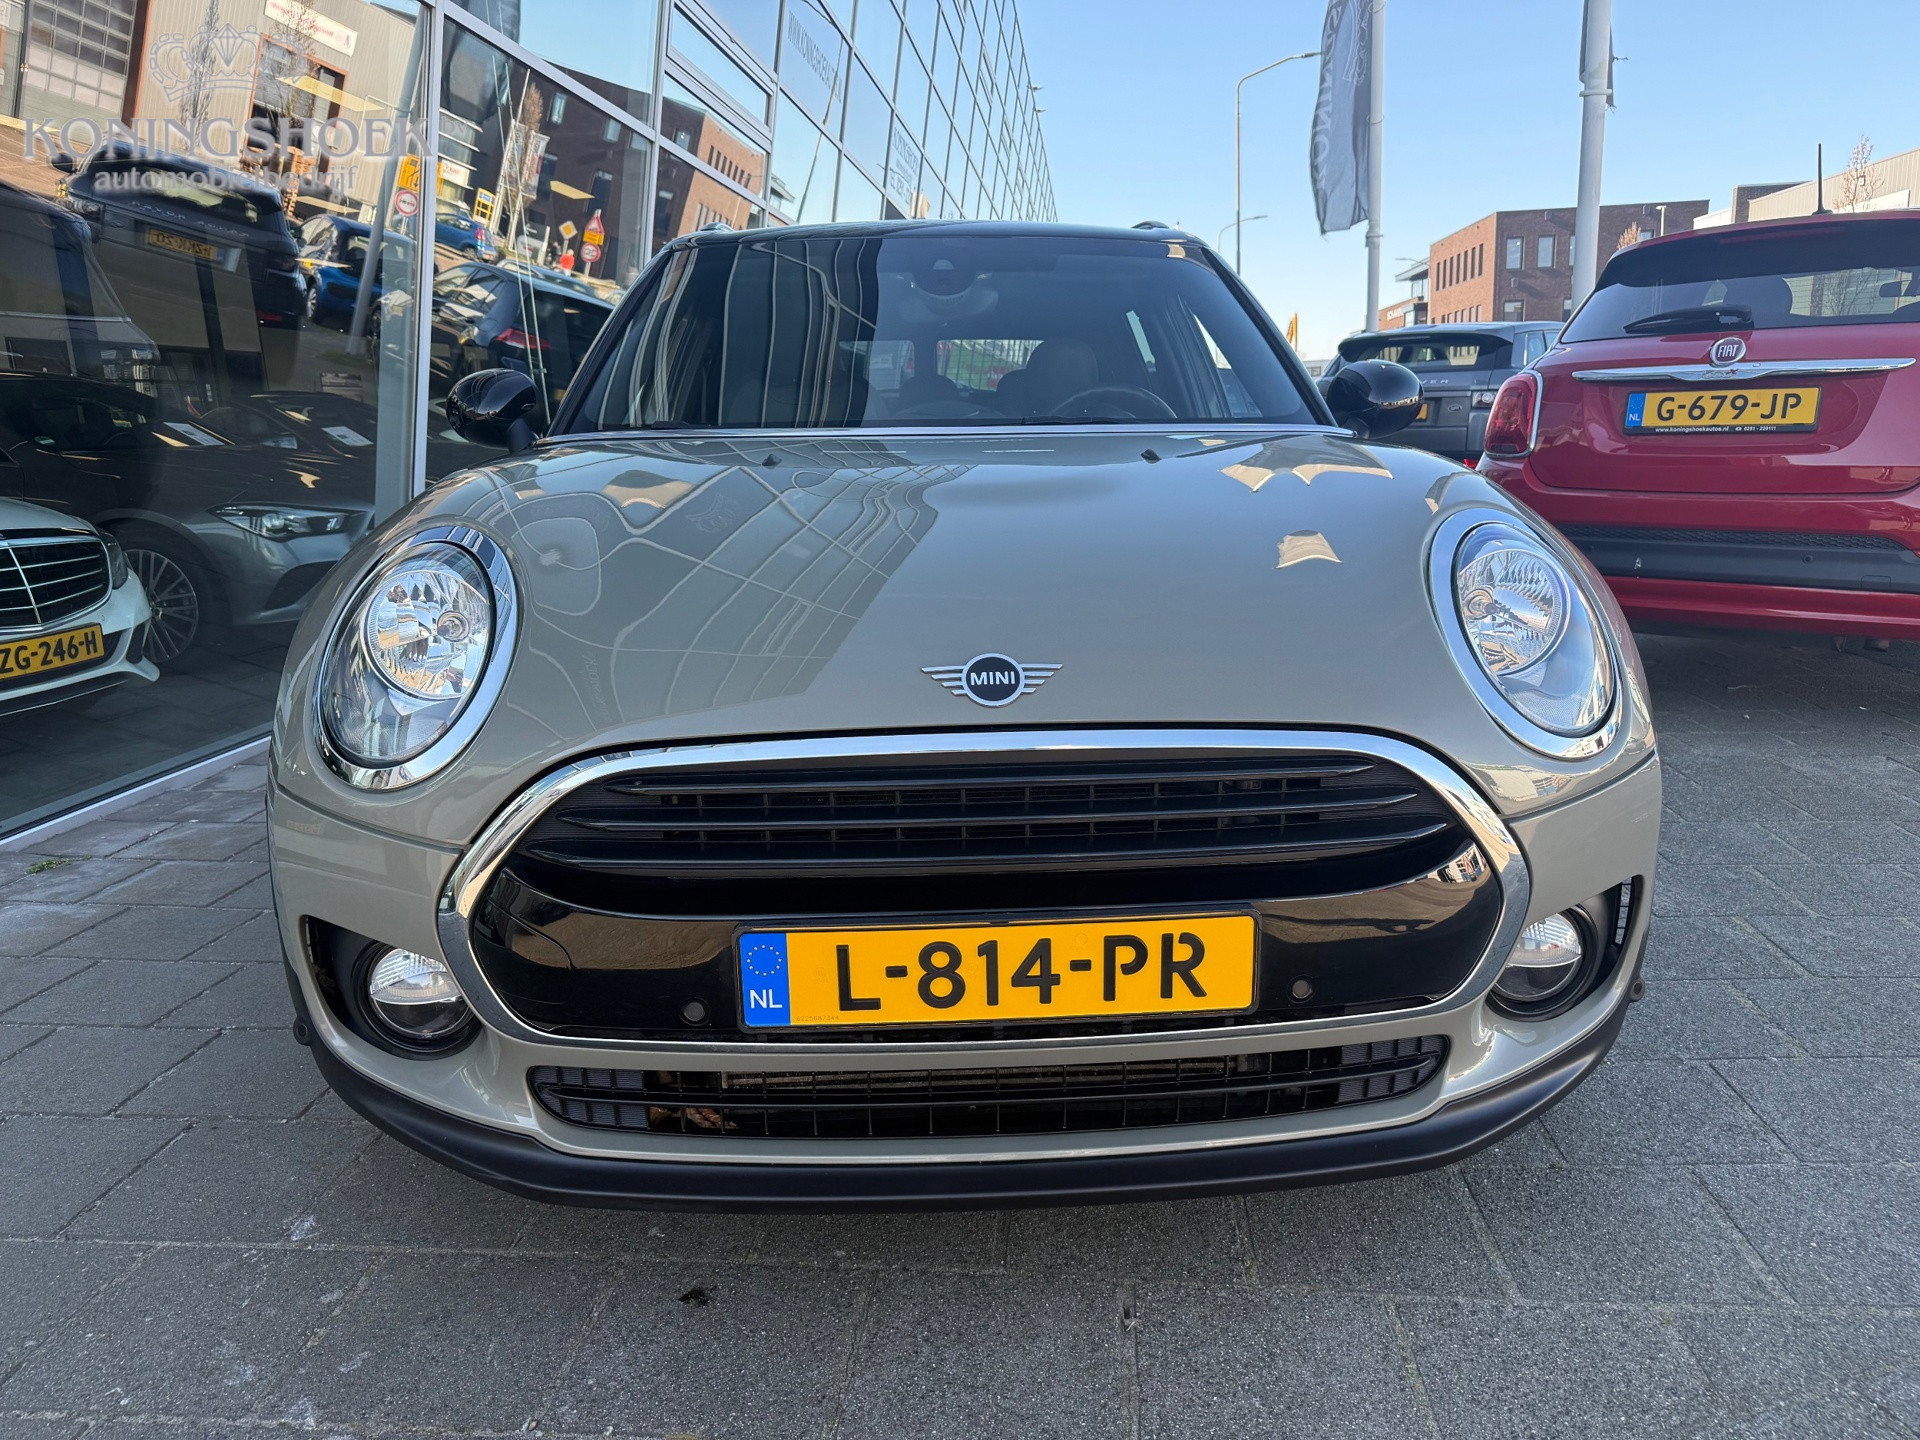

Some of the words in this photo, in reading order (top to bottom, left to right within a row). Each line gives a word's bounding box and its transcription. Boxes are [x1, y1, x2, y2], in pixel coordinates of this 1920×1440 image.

[1717, 344, 1739, 358] FIAT
[1656, 393, 1802, 422] G-679-JP
[1628, 412, 1641, 422] NL
[970, 671, 1016, 686] MINI
[836, 931, 1208, 1012] L-814-PR
[749, 989, 784, 1009] NL
